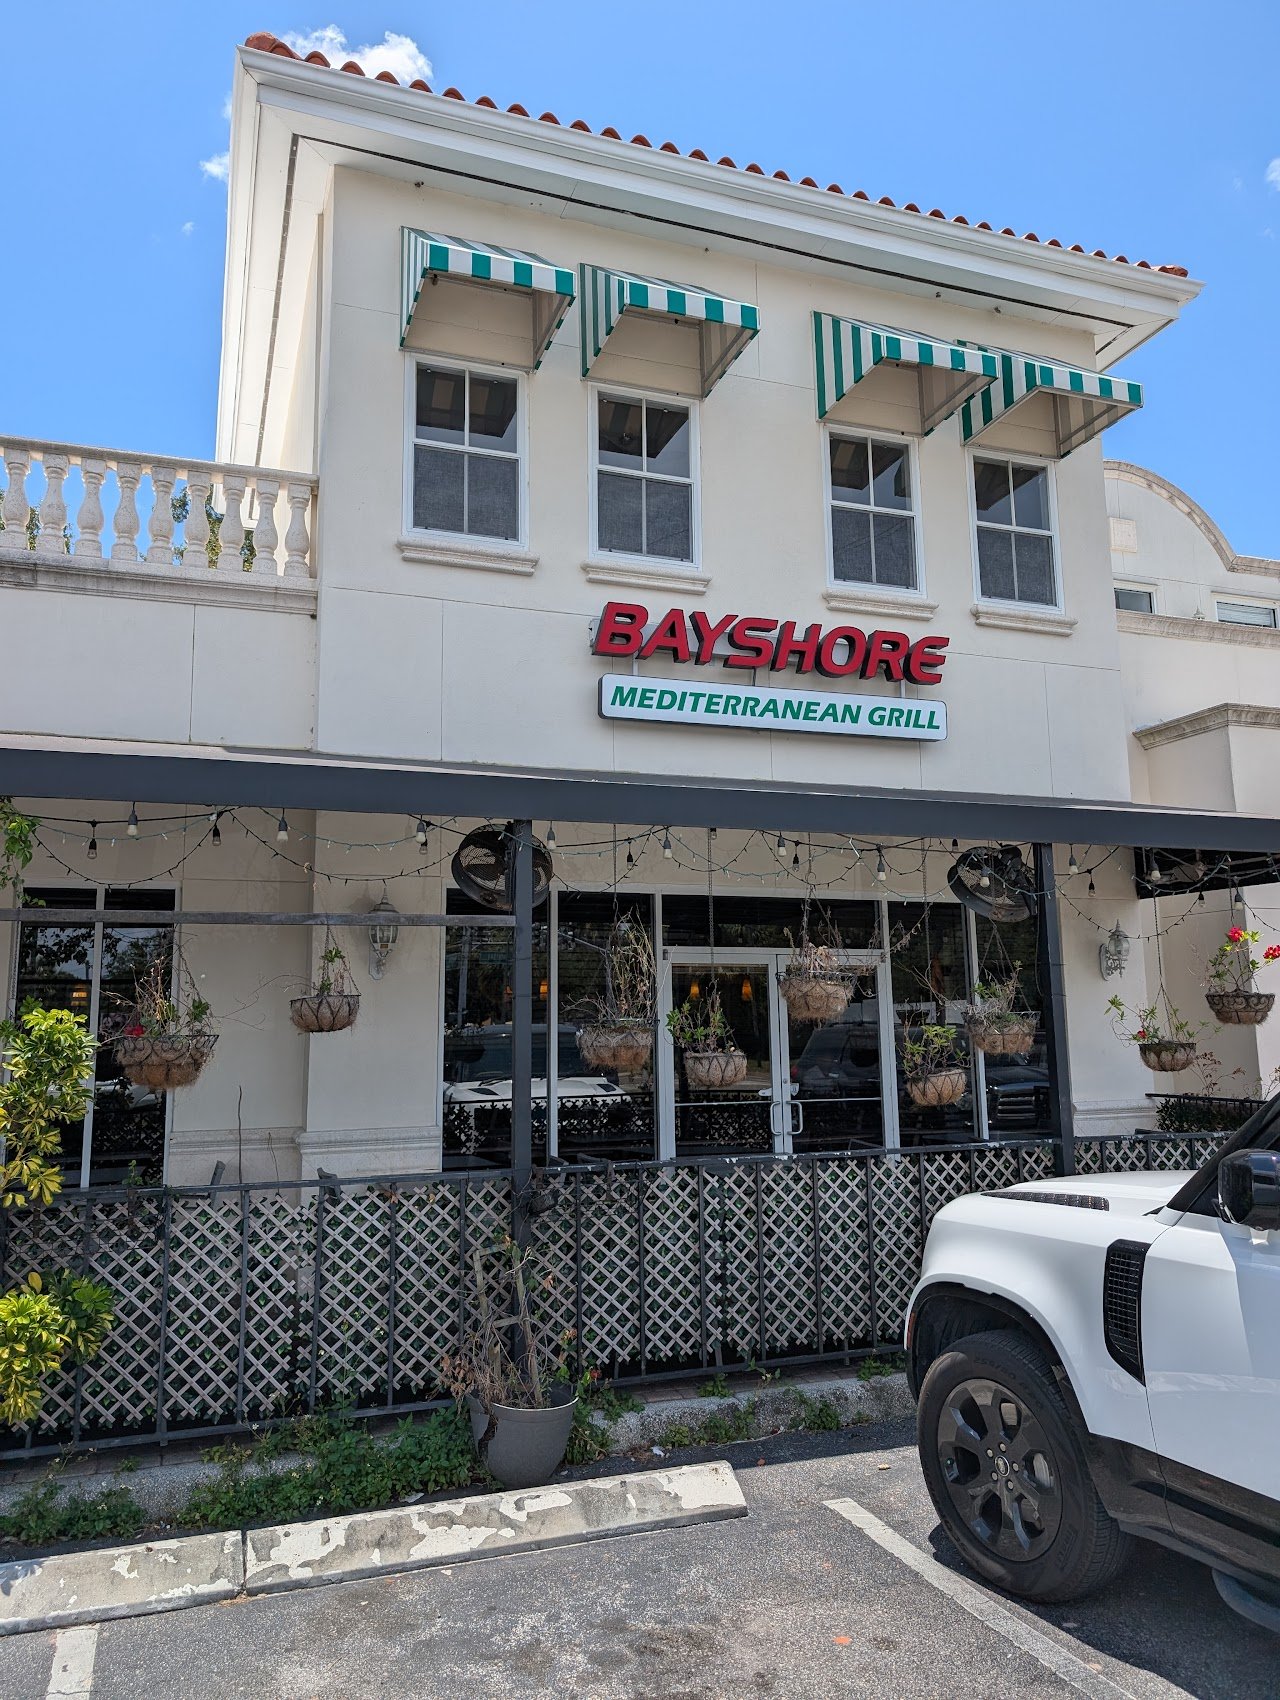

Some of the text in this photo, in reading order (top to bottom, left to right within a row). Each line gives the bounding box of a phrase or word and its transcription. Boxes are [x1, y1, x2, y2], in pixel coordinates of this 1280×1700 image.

[593, 602, 950, 684] BAYSHORE
[610, 685, 941, 730] MEDITERRANEAN GRILL
